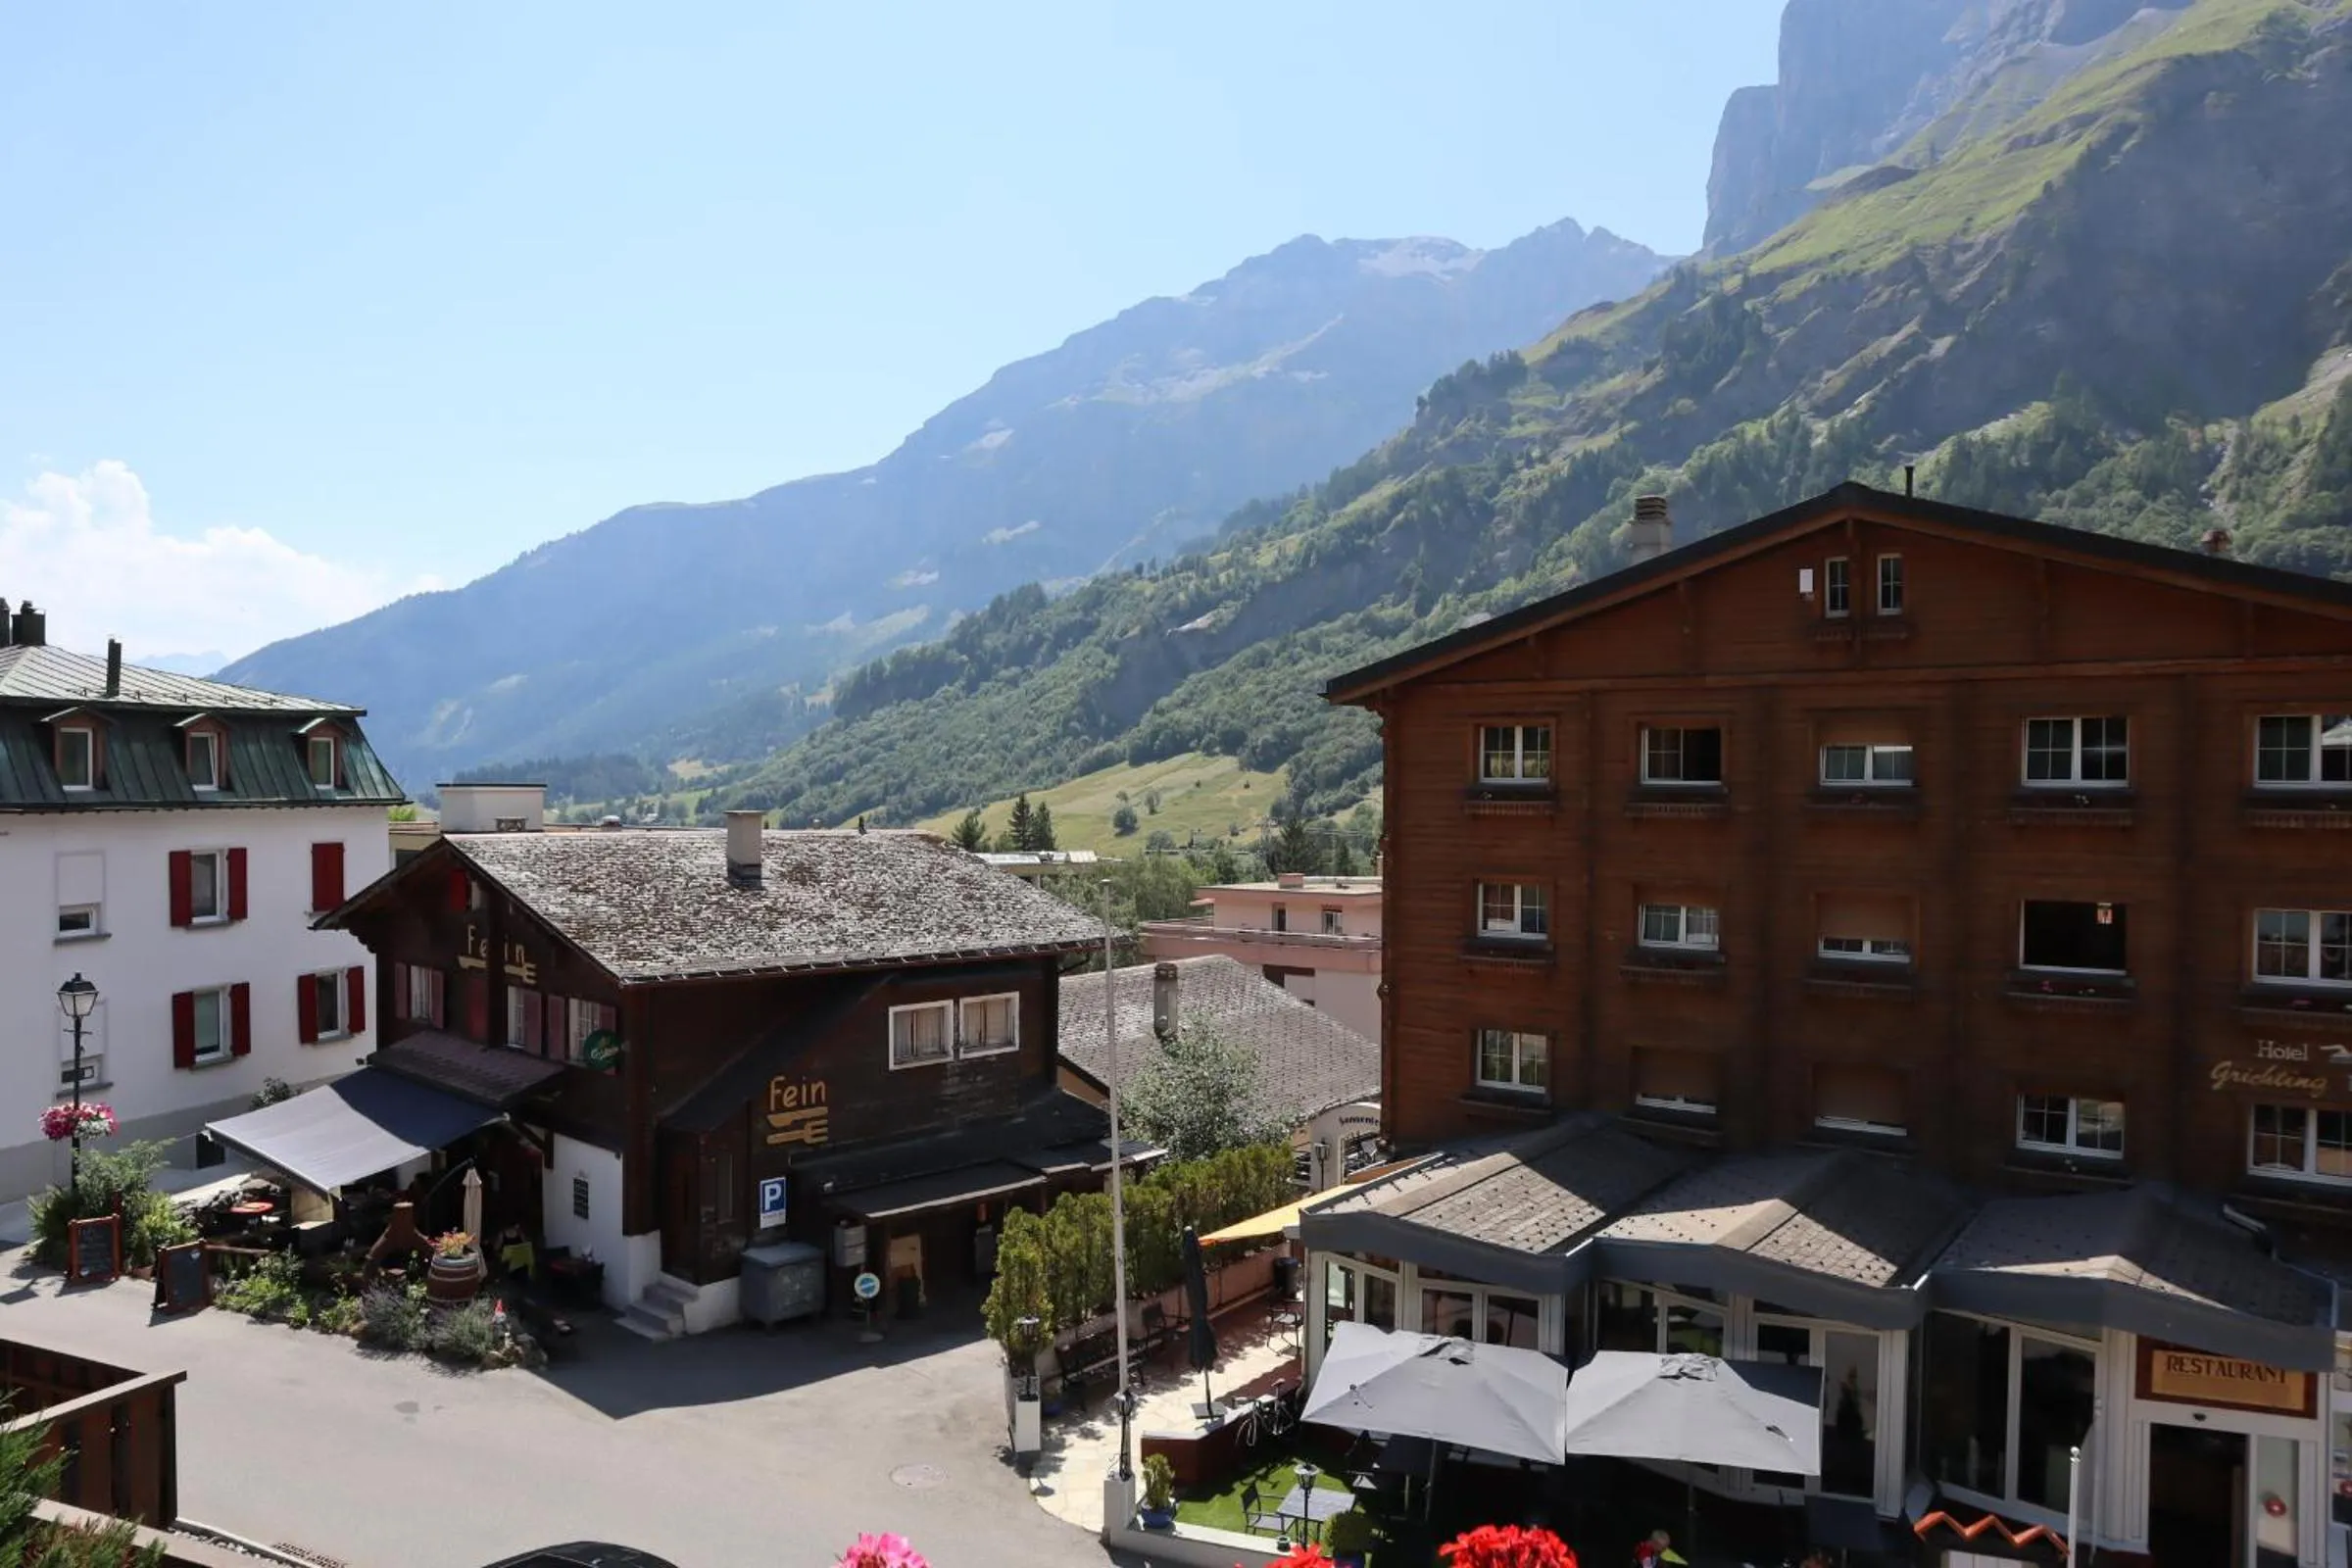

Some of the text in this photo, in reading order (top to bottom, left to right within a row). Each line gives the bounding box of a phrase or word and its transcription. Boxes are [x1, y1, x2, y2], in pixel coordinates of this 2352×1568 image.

[2257, 1040, 2309, 1061] Hotel
[769, 1075, 826, 1112] Fein
[2210, 1059, 2328, 1099] Grichting
[764, 1183, 782, 1211] P
[2166, 1354, 2287, 1385] RESTAURANT
